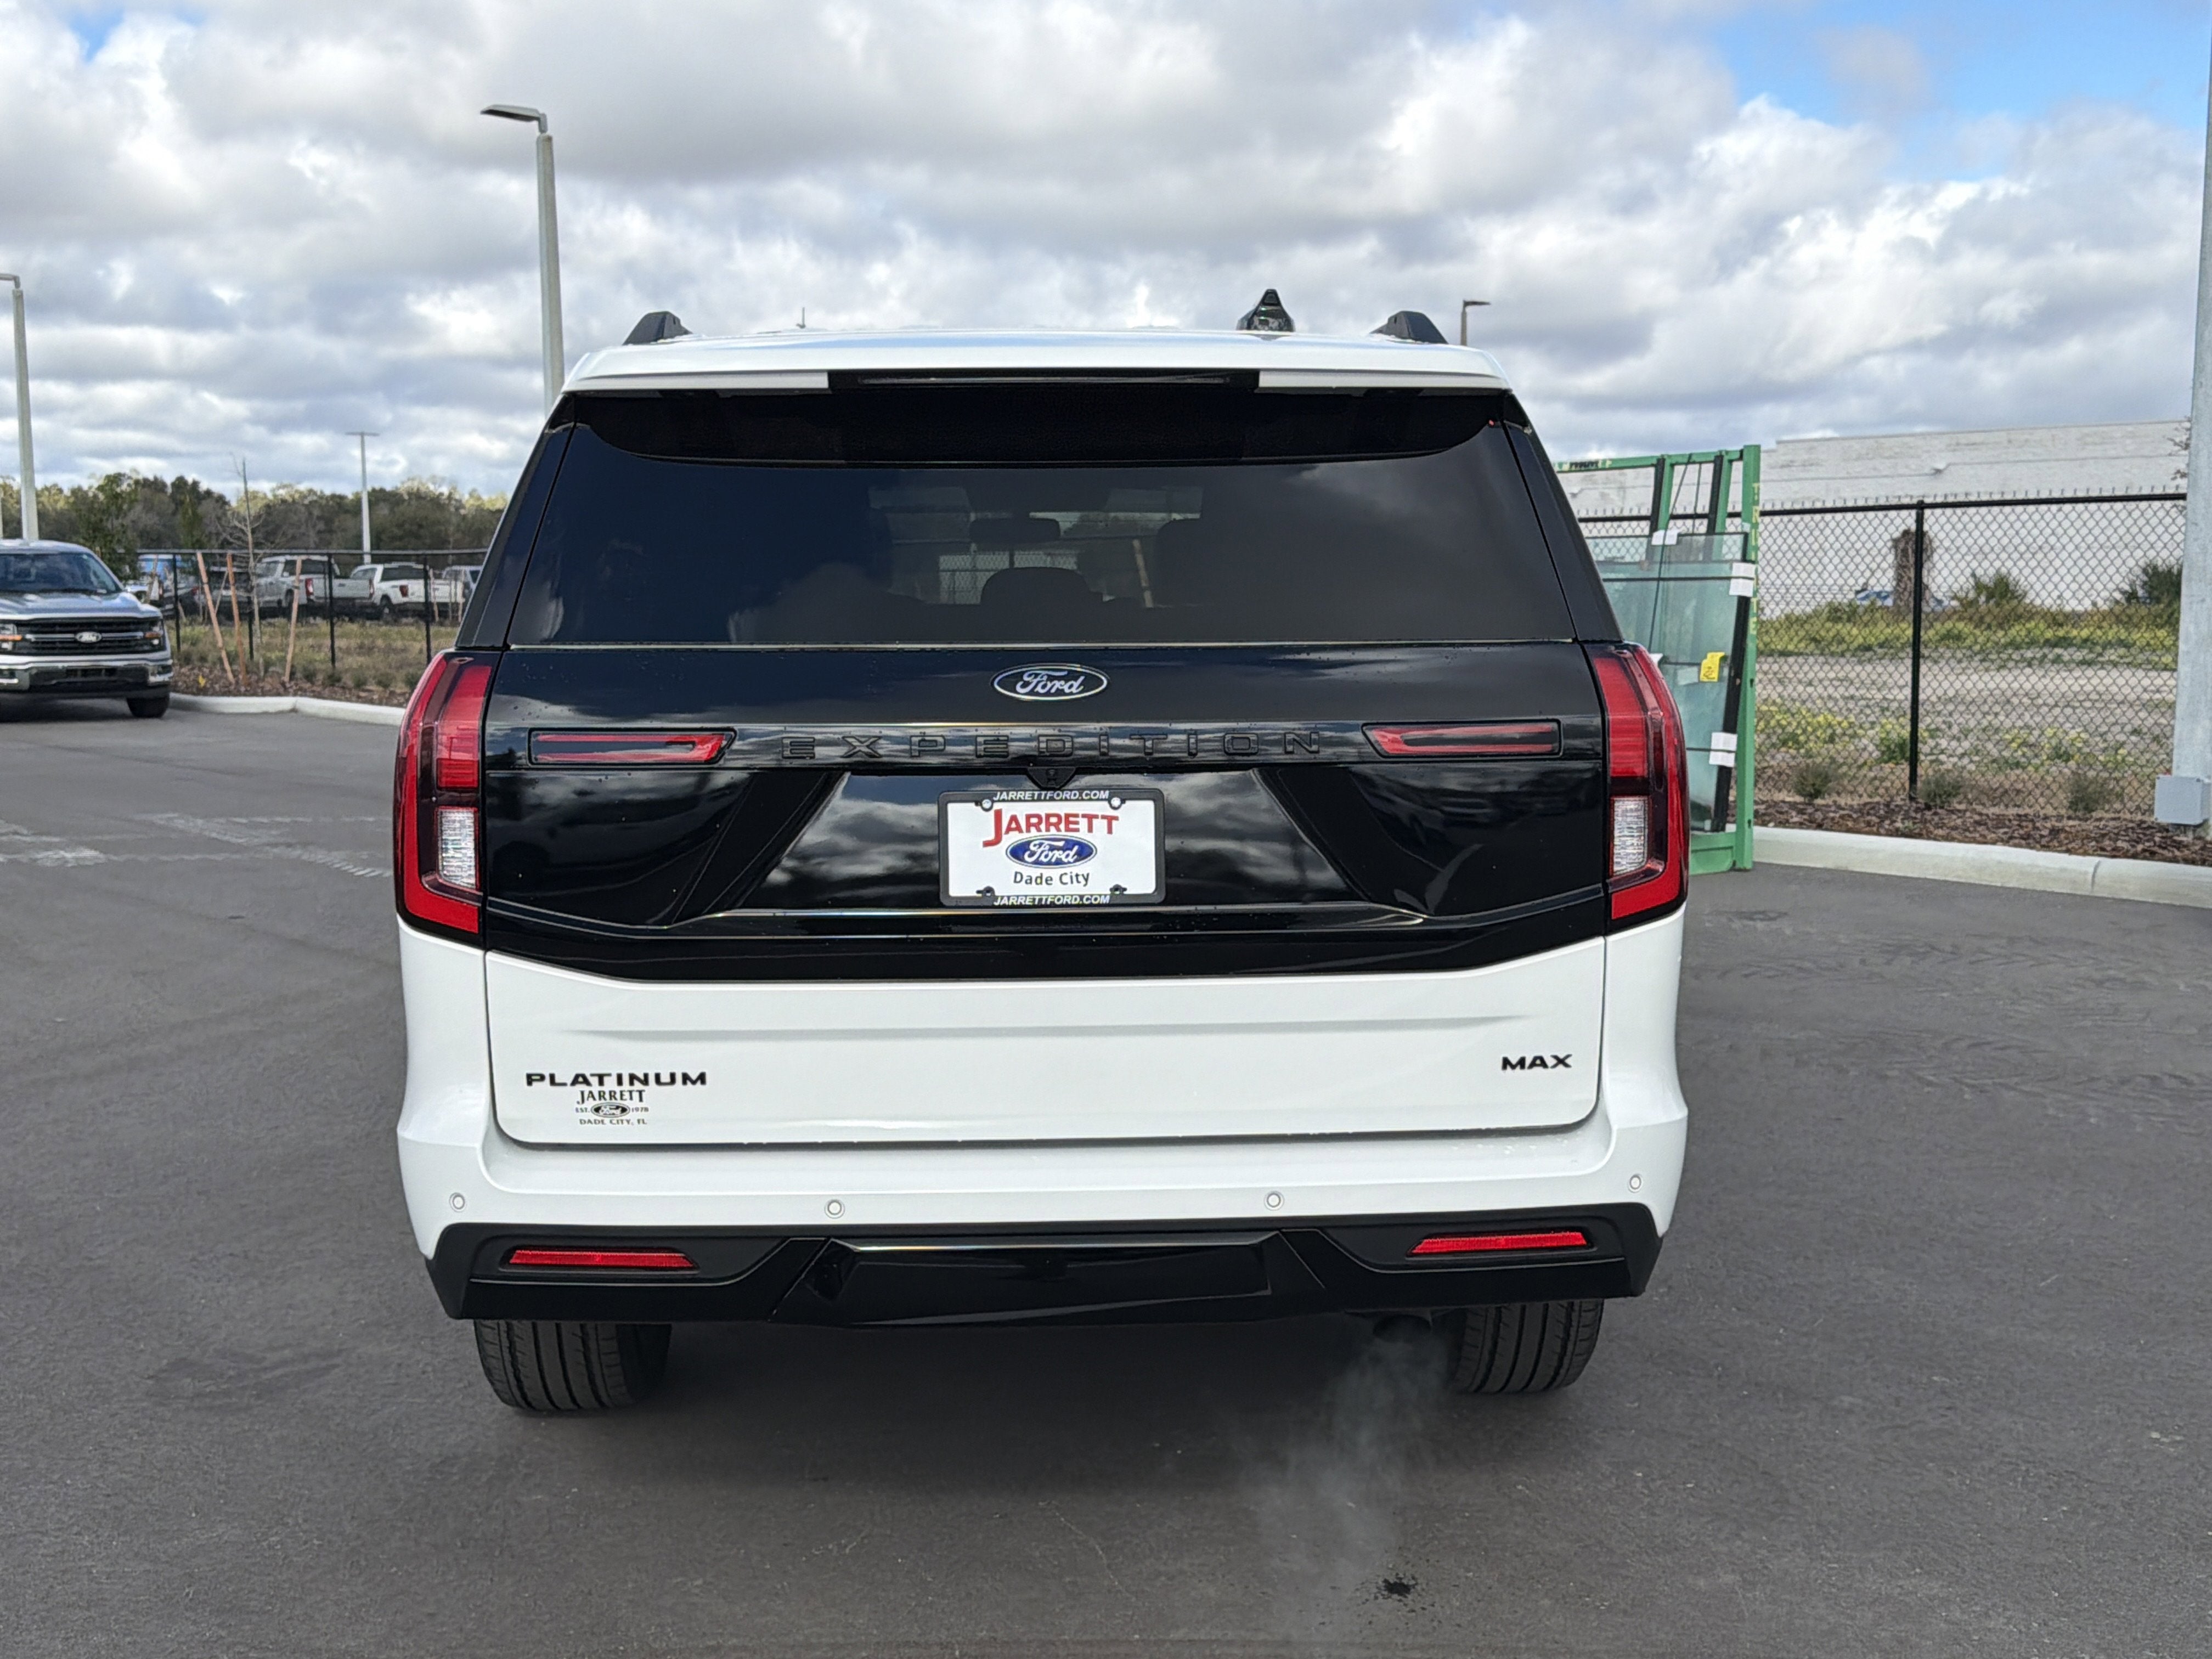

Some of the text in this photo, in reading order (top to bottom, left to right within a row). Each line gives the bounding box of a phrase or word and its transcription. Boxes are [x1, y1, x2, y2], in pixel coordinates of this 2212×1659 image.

[1015, 670, 1085, 693] Ford
[782, 731, 1319, 759] EXPEDITION
[992, 790, 1110, 801] JARRETTFORD.COM
[983, 809, 1119, 847] JARRETT
[1024, 840, 1079, 862] Ford
[1013, 871, 1090, 887] Dade City
[994, 895, 1110, 906] JARRETTFORD.COM
[1502, 1054, 1572, 1070] MAX
[526, 1071, 707, 1087] PLATINUM
[576, 1090, 646, 1105] JARRETT
